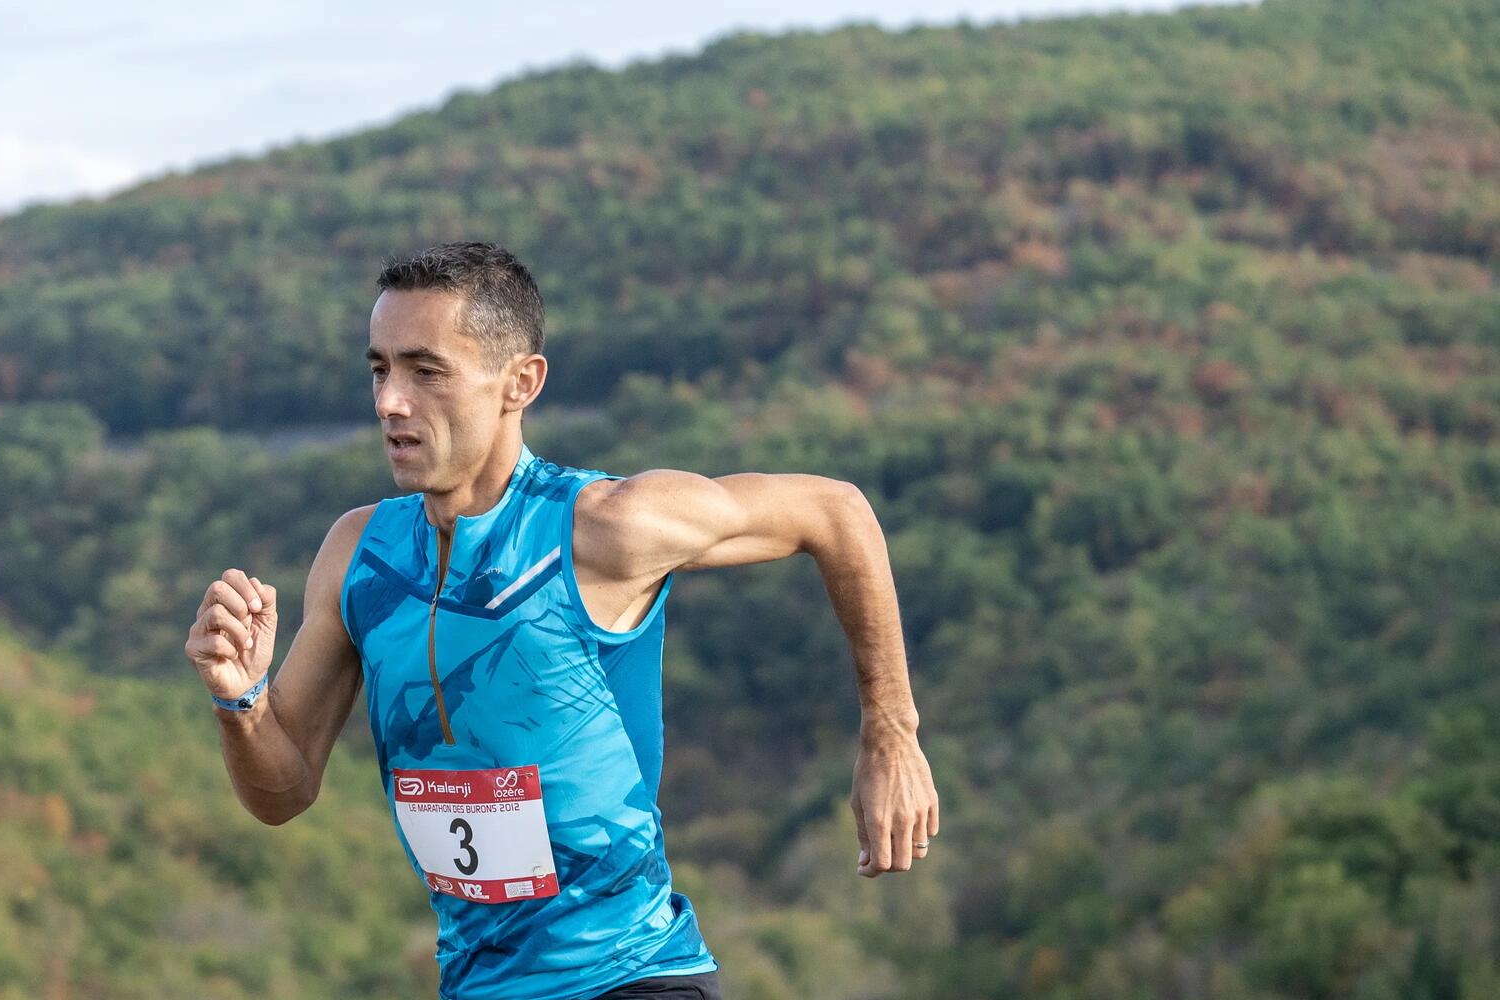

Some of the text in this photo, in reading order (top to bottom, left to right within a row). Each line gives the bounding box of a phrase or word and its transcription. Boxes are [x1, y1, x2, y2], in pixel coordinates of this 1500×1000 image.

[427, 781, 472, 798] Kalenji
[409, 803, 520, 814] LE MARATHON DES BURONS 2012
[449, 817, 479, 876] 3
